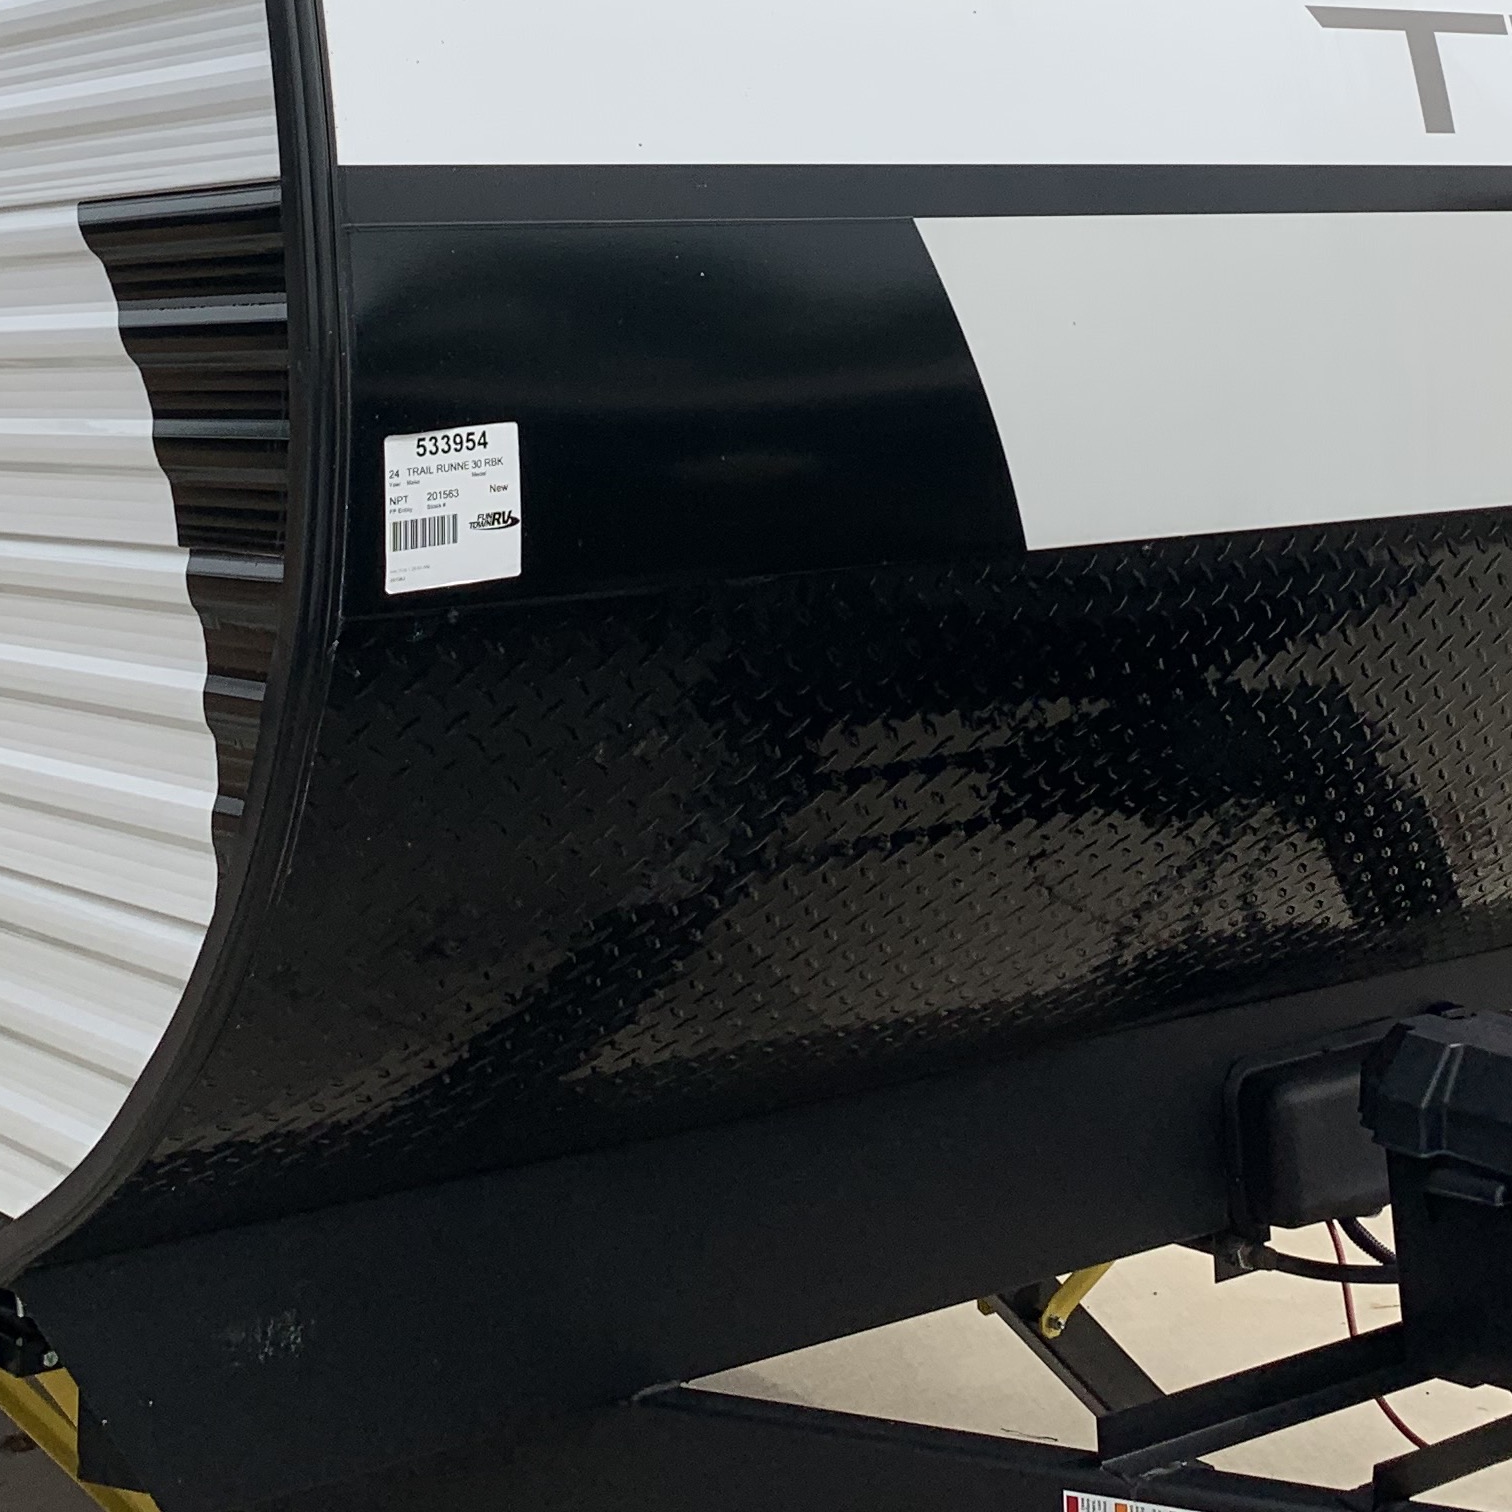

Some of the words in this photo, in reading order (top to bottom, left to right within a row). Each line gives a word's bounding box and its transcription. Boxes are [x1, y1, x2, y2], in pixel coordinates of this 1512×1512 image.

[416, 430, 488, 457] 533954
[389, 469, 400, 480] 24
[407, 466, 434, 477] TRAIL
[436, 460, 470, 474] RUNNE
[471, 459, 483, 469] 30
[484, 456, 504, 468] RBK
[489, 483, 509, 493] New
[389, 494, 409, 506] NPT
[477, 512, 493, 522] FUN
[492, 510, 513, 526] RV
